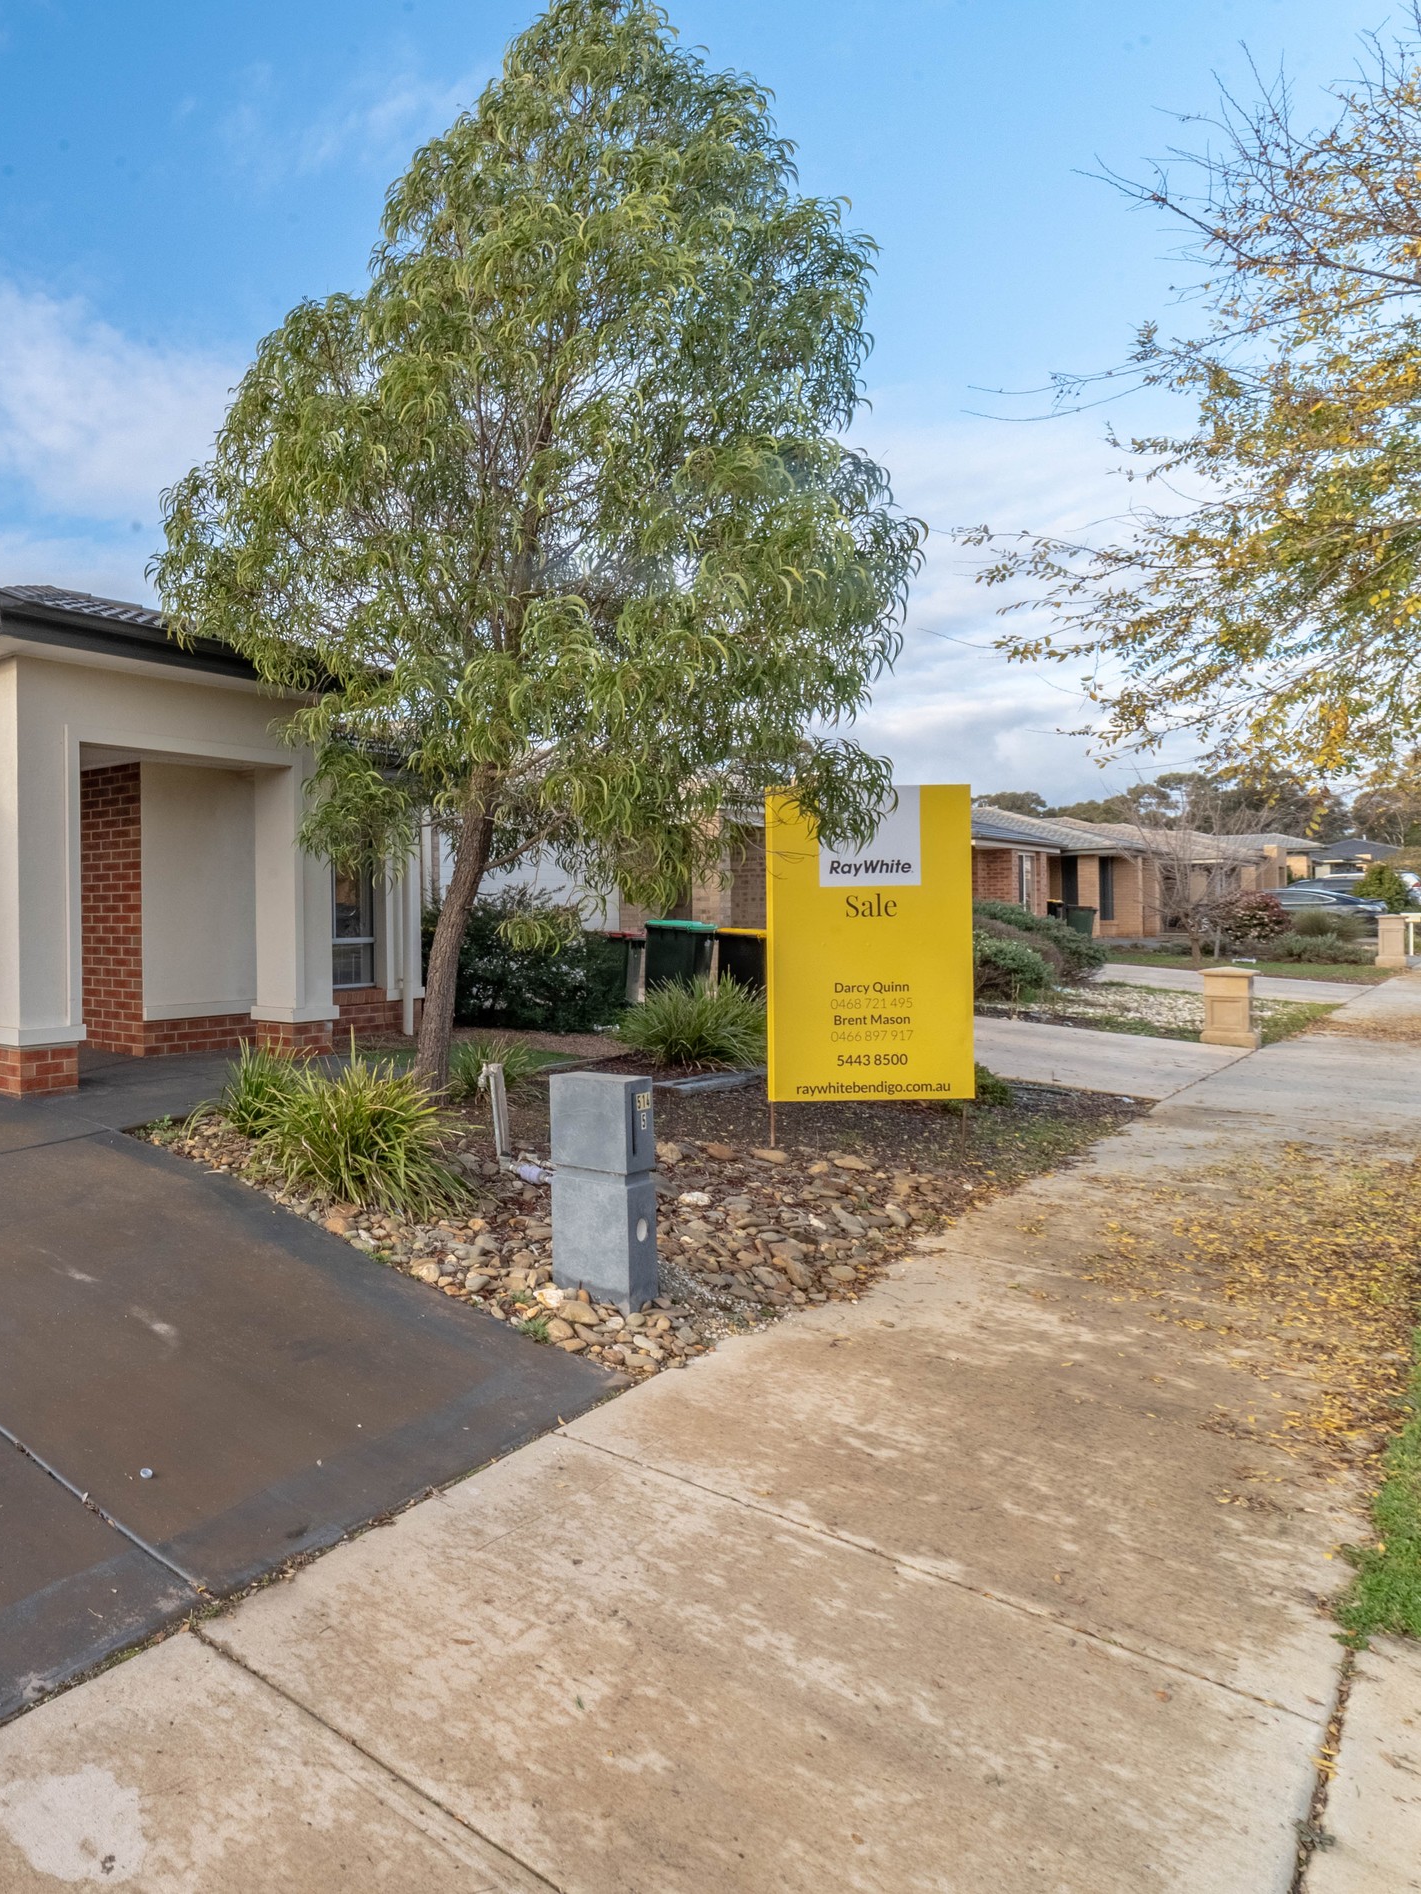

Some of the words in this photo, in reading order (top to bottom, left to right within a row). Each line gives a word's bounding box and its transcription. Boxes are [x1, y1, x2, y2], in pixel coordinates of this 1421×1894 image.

[845, 893, 898, 918] Sale
[834, 982, 870, 995] Darcy
[872, 981, 910, 994] Quinn
[830, 998, 862, 1010] 0468
[864, 998, 887, 1009] 721
[890, 997, 913, 1009] 495
[833, 1014, 868, 1026] Brent
[870, 1014, 911, 1025] Mason
[830, 1031, 862, 1042] 0466
[864, 1030, 888, 1041] 897
[890, 1029, 914, 1041] 917
[836, 1054, 871, 1067] 5443
[873, 1053, 908, 1066] 8500
[796, 1081, 951, 1096] raywhitebendigo.com.au
